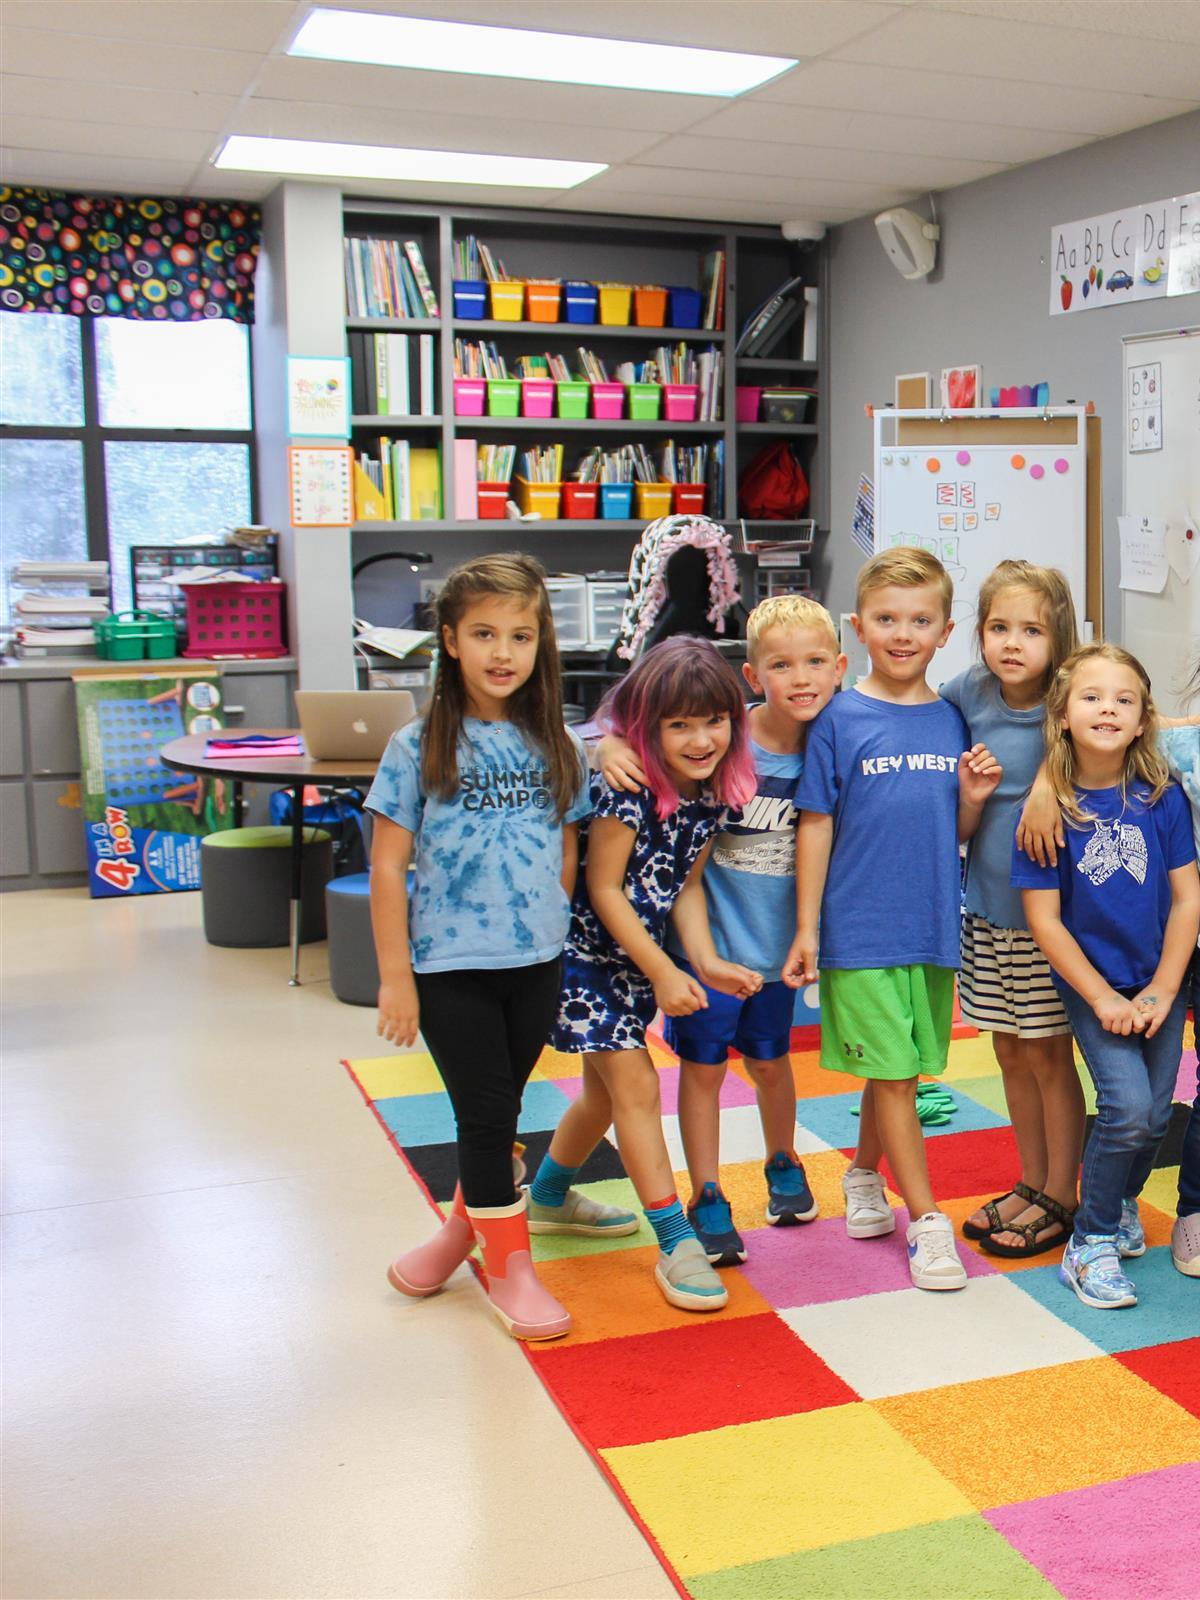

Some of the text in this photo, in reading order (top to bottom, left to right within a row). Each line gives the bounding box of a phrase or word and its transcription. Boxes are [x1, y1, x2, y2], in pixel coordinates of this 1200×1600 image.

[862, 753, 958, 776] KEY WEST
[463, 789, 530, 811] CAMP
[105, 806, 137, 856] ROW
